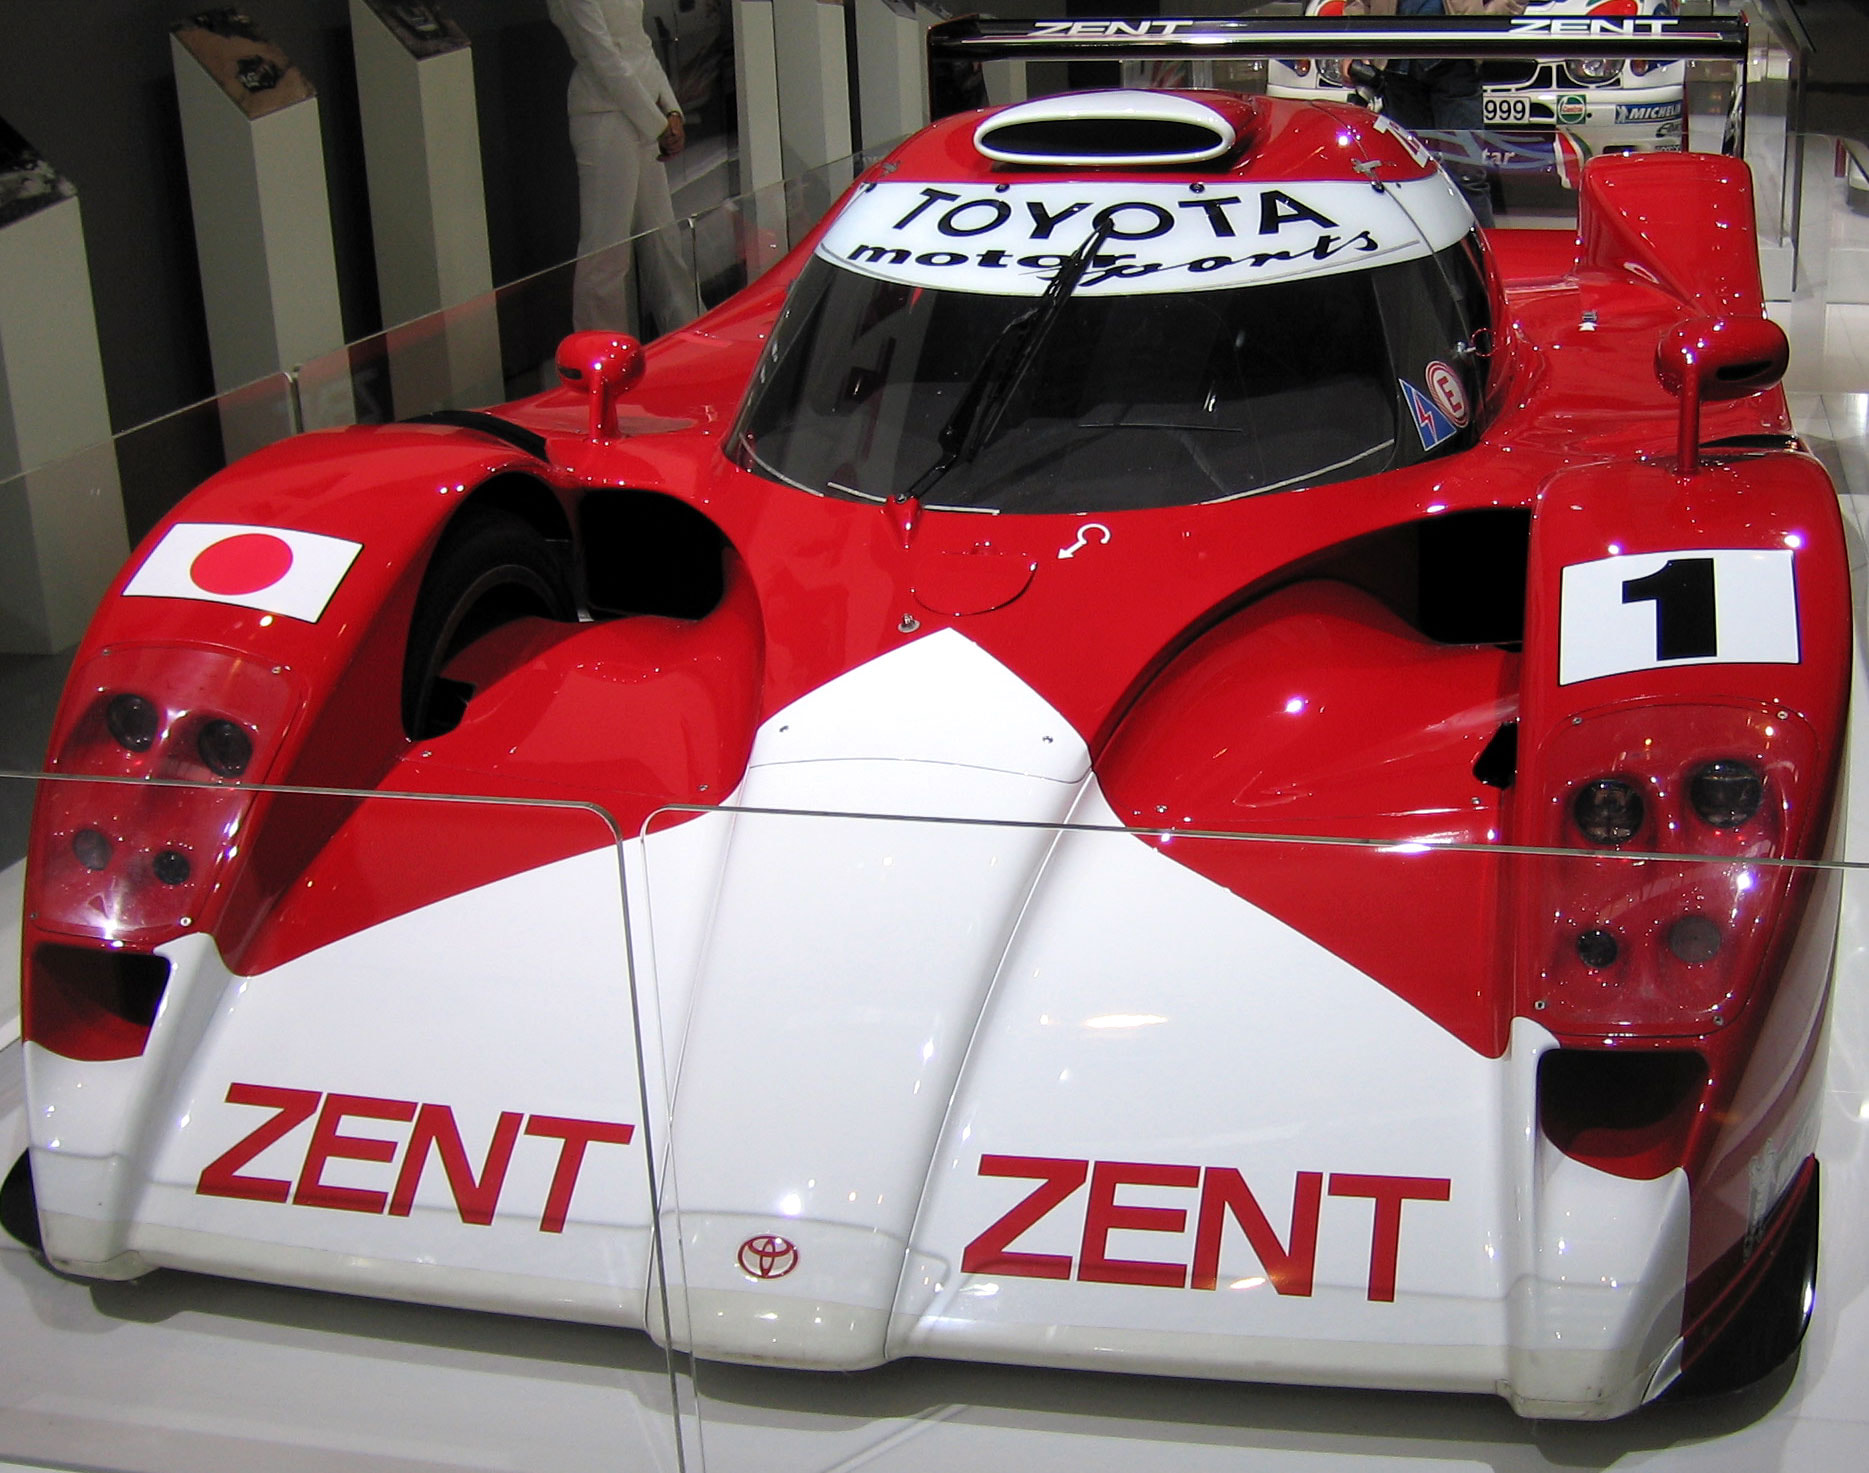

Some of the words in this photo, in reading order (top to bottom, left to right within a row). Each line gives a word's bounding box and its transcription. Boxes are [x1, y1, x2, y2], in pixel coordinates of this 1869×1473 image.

[1027, 20, 1193, 37] ZENT
[1509, 19, 1678, 36] ZENT
[1484, 99, 1526, 121] 999
[1628, 103, 1681, 120] MICHELI
[893, 188, 1337, 241] TOYOTA
[1622, 557, 1717, 661] 1
[198, 1083, 634, 1233] ZENT
[962, 1155, 1451, 1302] ZENT
